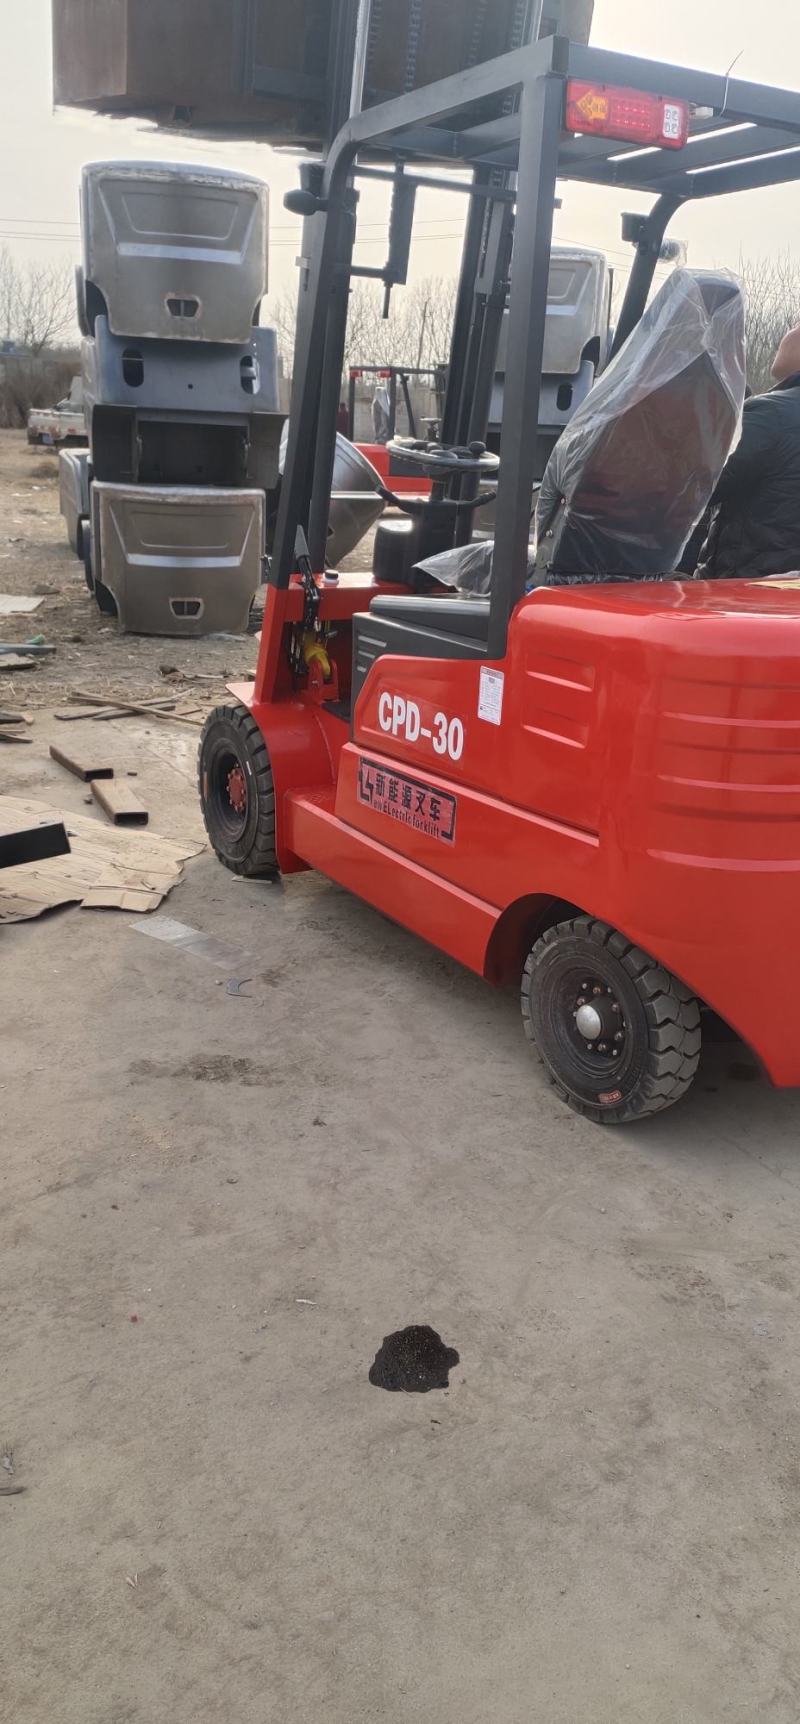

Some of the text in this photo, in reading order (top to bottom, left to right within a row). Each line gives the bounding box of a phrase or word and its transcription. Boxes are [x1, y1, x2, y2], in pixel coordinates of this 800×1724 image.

[379, 692, 463, 760] CPD-30
[375, 773, 441, 821] 新能源叉车
